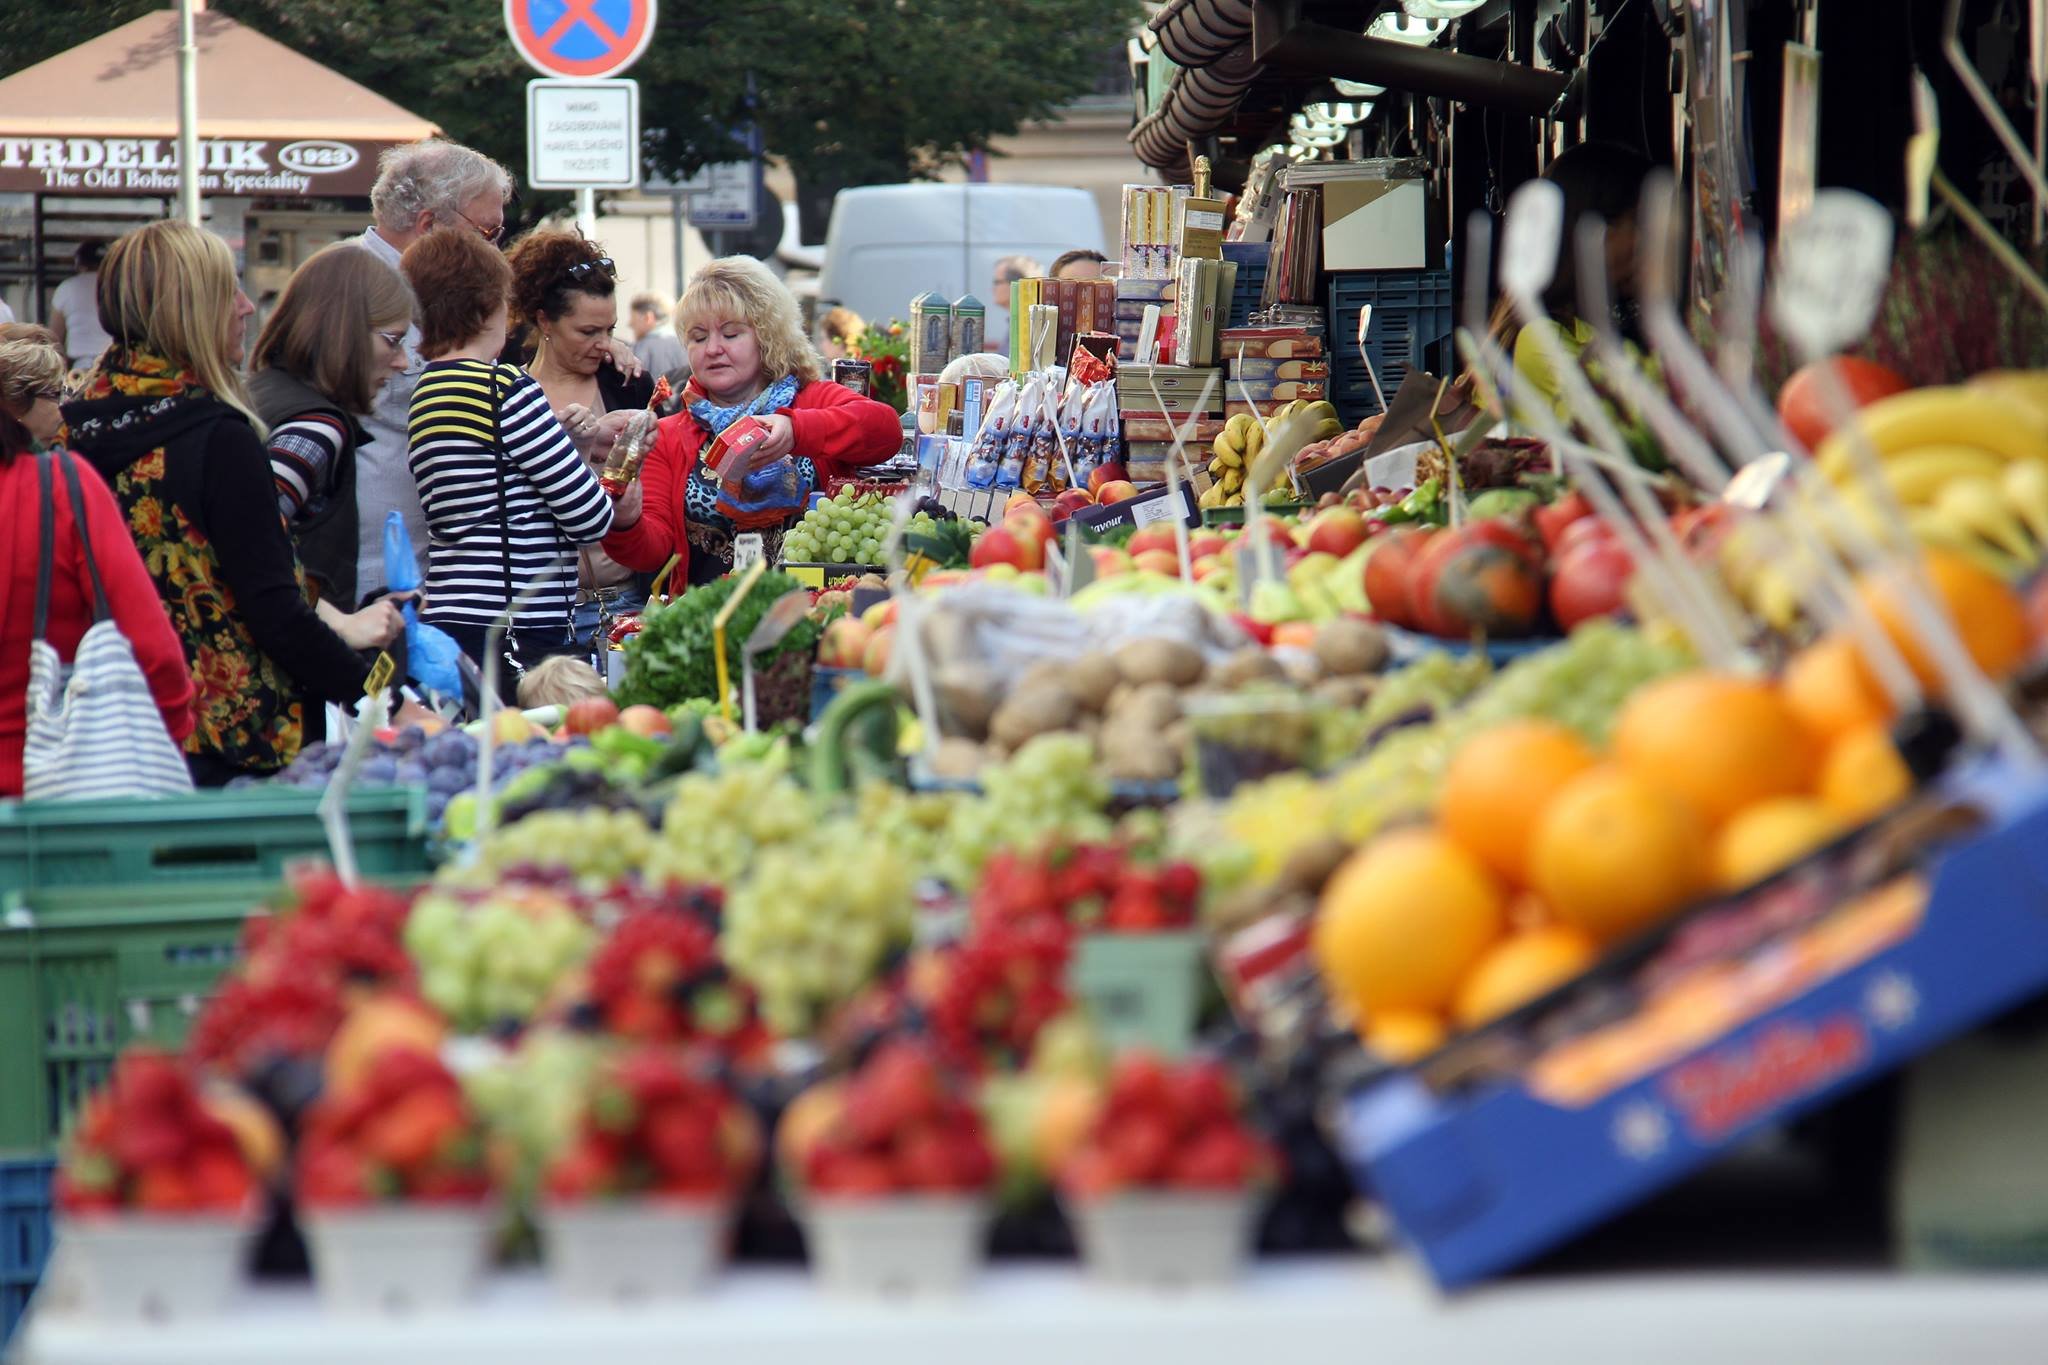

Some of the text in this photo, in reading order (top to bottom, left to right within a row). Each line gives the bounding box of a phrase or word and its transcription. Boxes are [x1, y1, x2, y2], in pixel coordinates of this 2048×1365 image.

[41, 168, 79, 187] The
[84, 168, 120, 188] Old
[223, 169, 311, 194] Speciality
